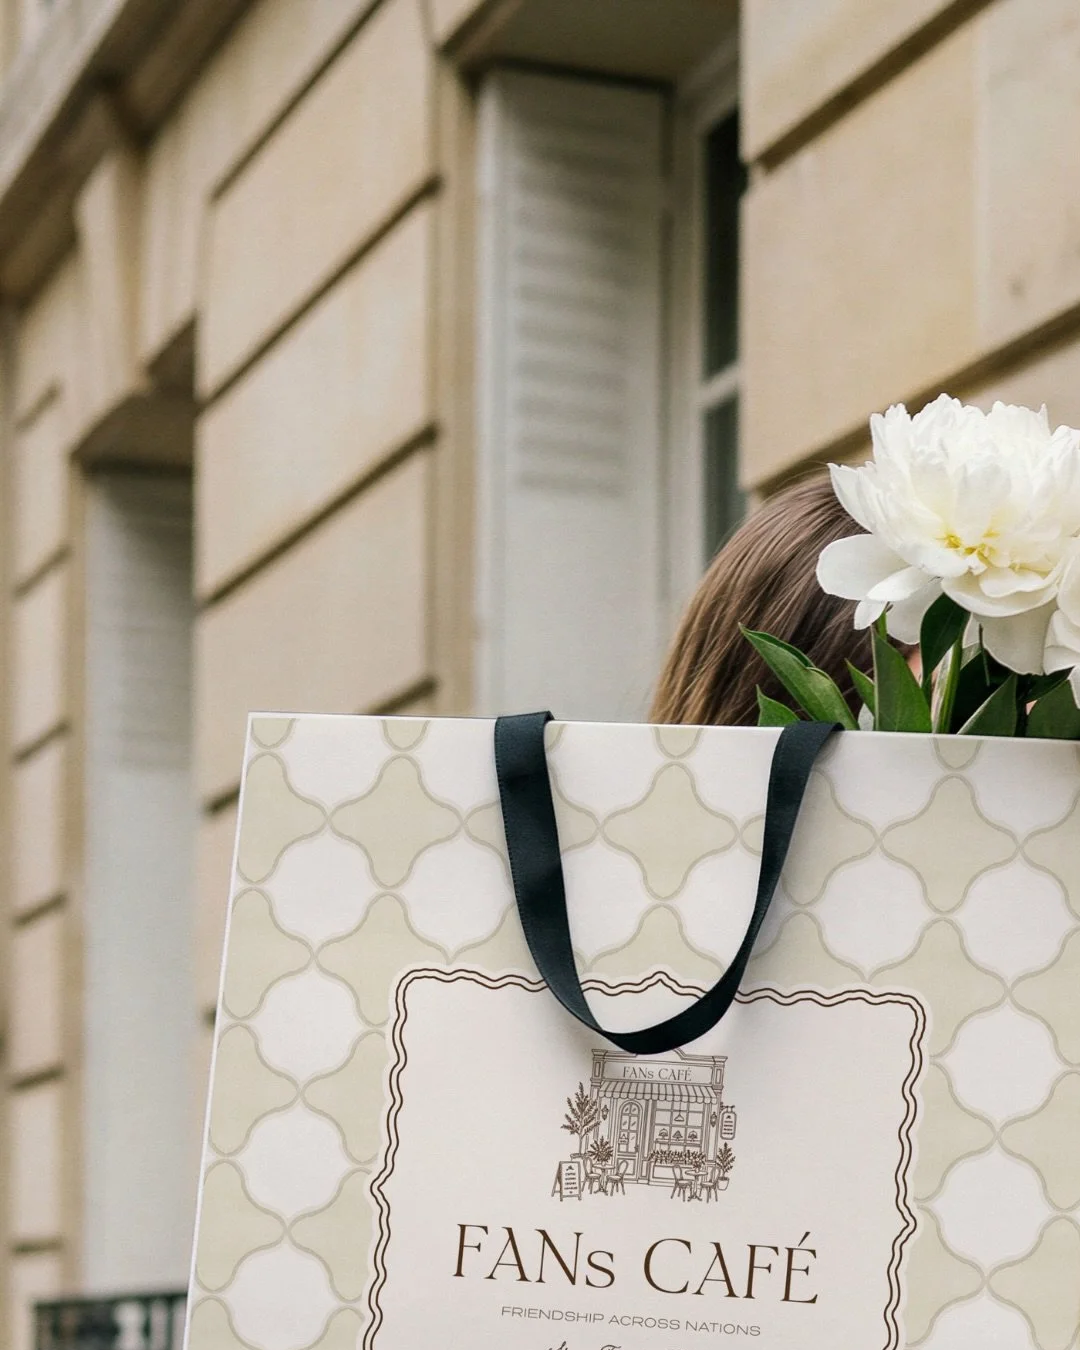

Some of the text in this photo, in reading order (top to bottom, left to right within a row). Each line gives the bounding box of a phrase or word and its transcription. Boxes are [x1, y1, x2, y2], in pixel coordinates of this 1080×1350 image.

[622, 1066, 692, 1082] FANs CAFÉ
[452, 1223, 819, 1304] FANs CAFÉ
[501, 1306, 761, 1337] FRIENDSHIP ACROSS NATIONS
